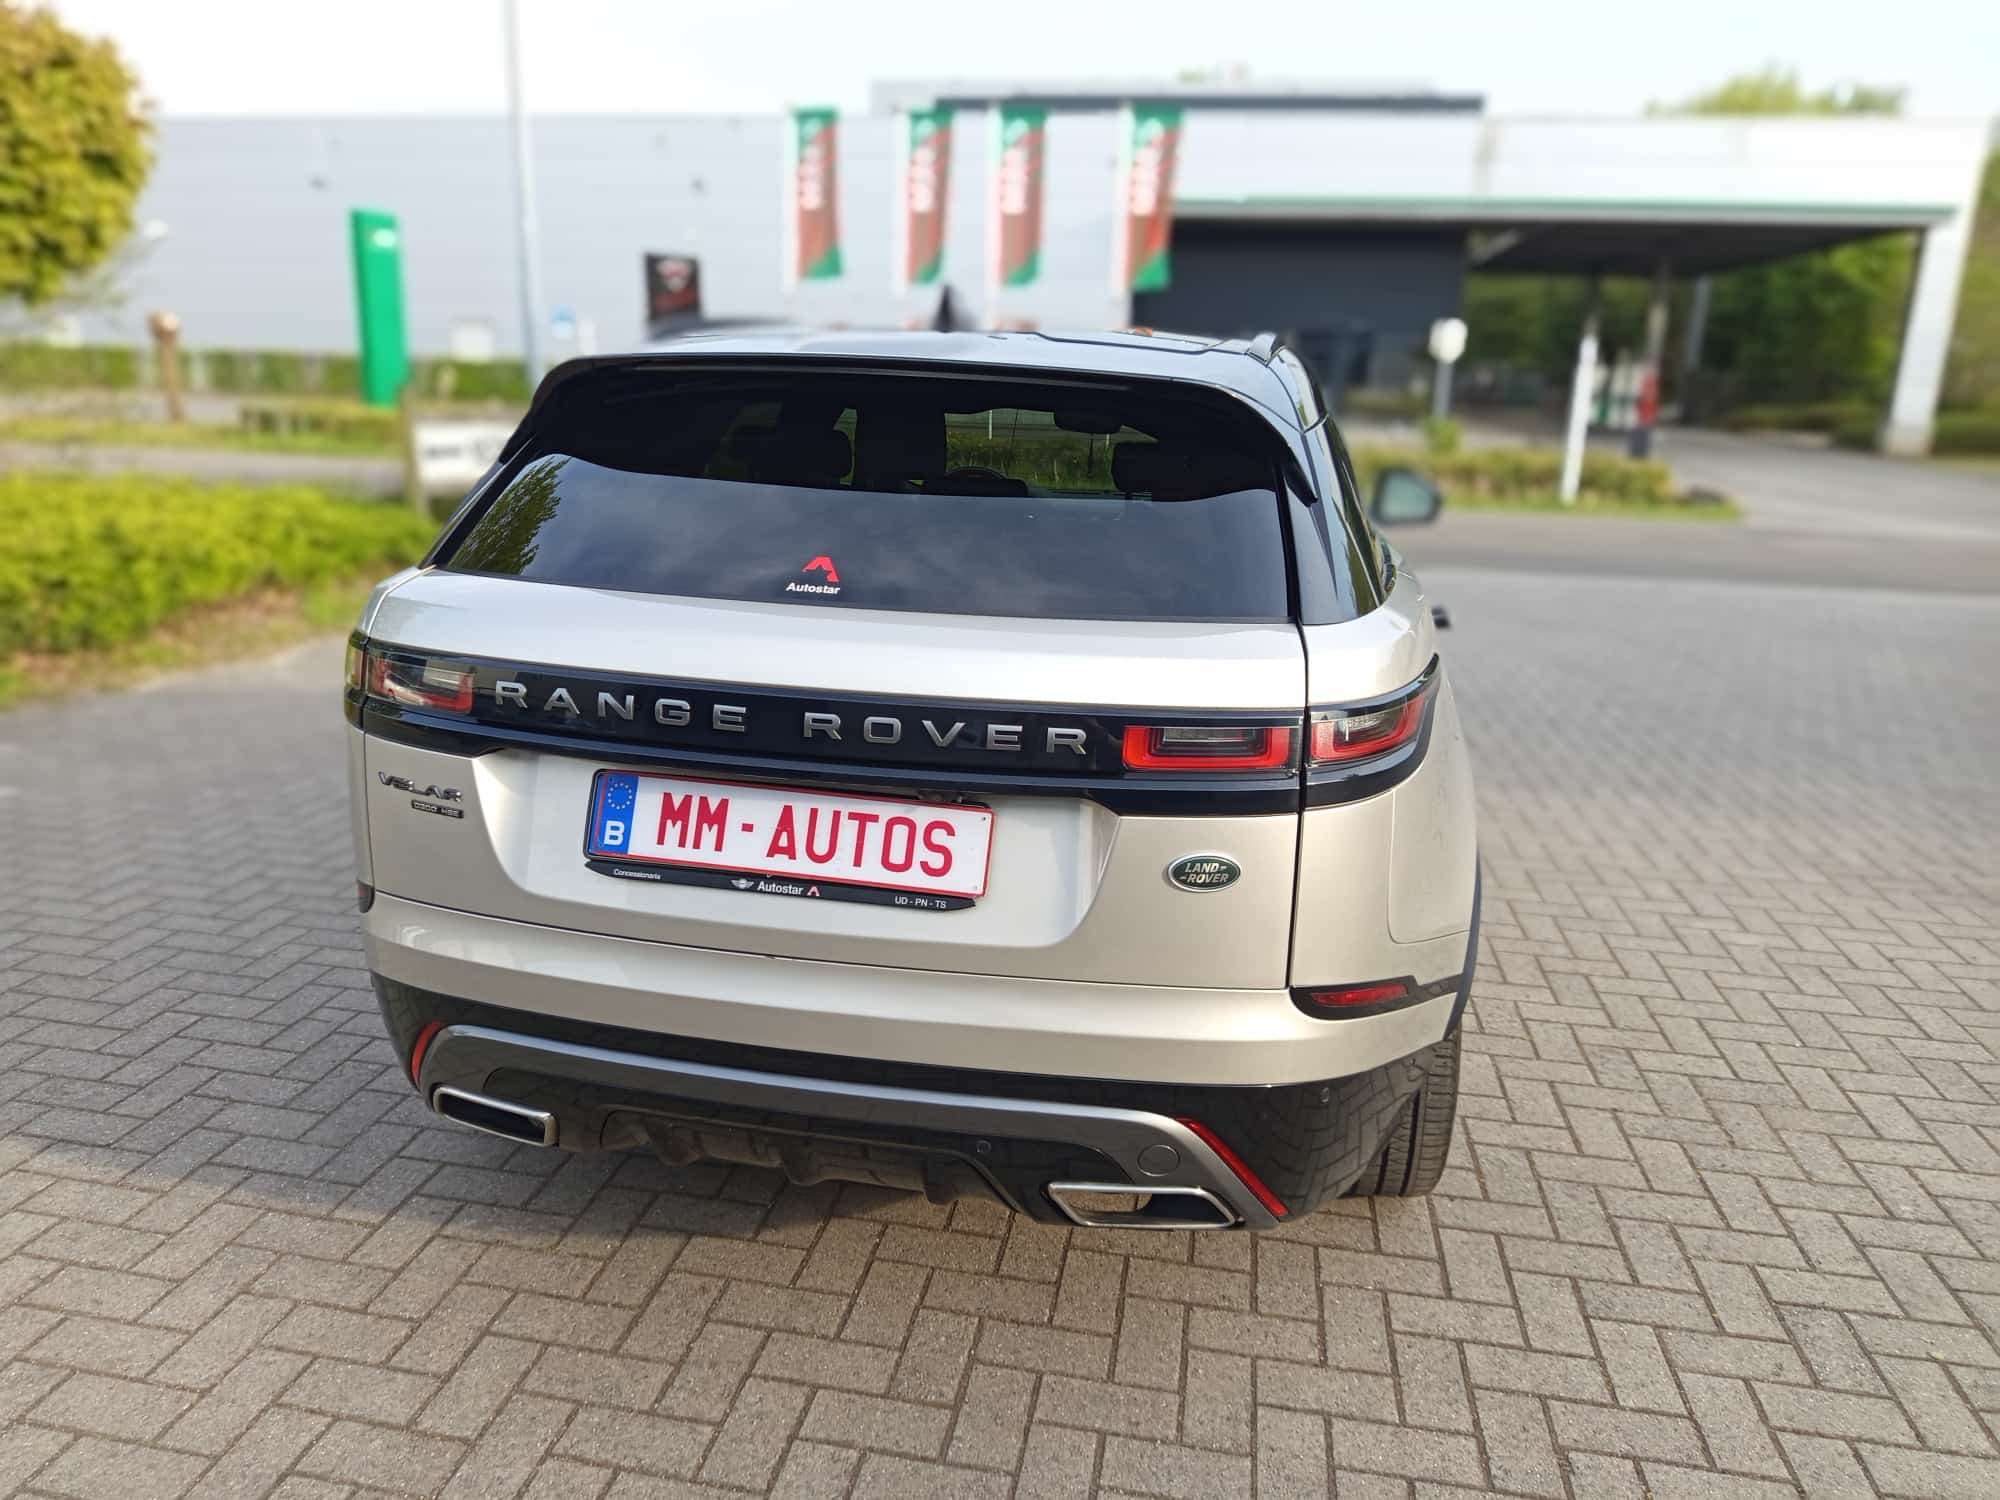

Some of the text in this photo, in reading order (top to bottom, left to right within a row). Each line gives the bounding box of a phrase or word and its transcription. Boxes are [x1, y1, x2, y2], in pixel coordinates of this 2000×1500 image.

[785, 582, 841, 594] Autostar
[495, 680, 1087, 754] RANGE ROVER
[378, 771, 462, 802] VELAR
[604, 821, 625, 846] B
[757, 881, 804, 896] Autostar
